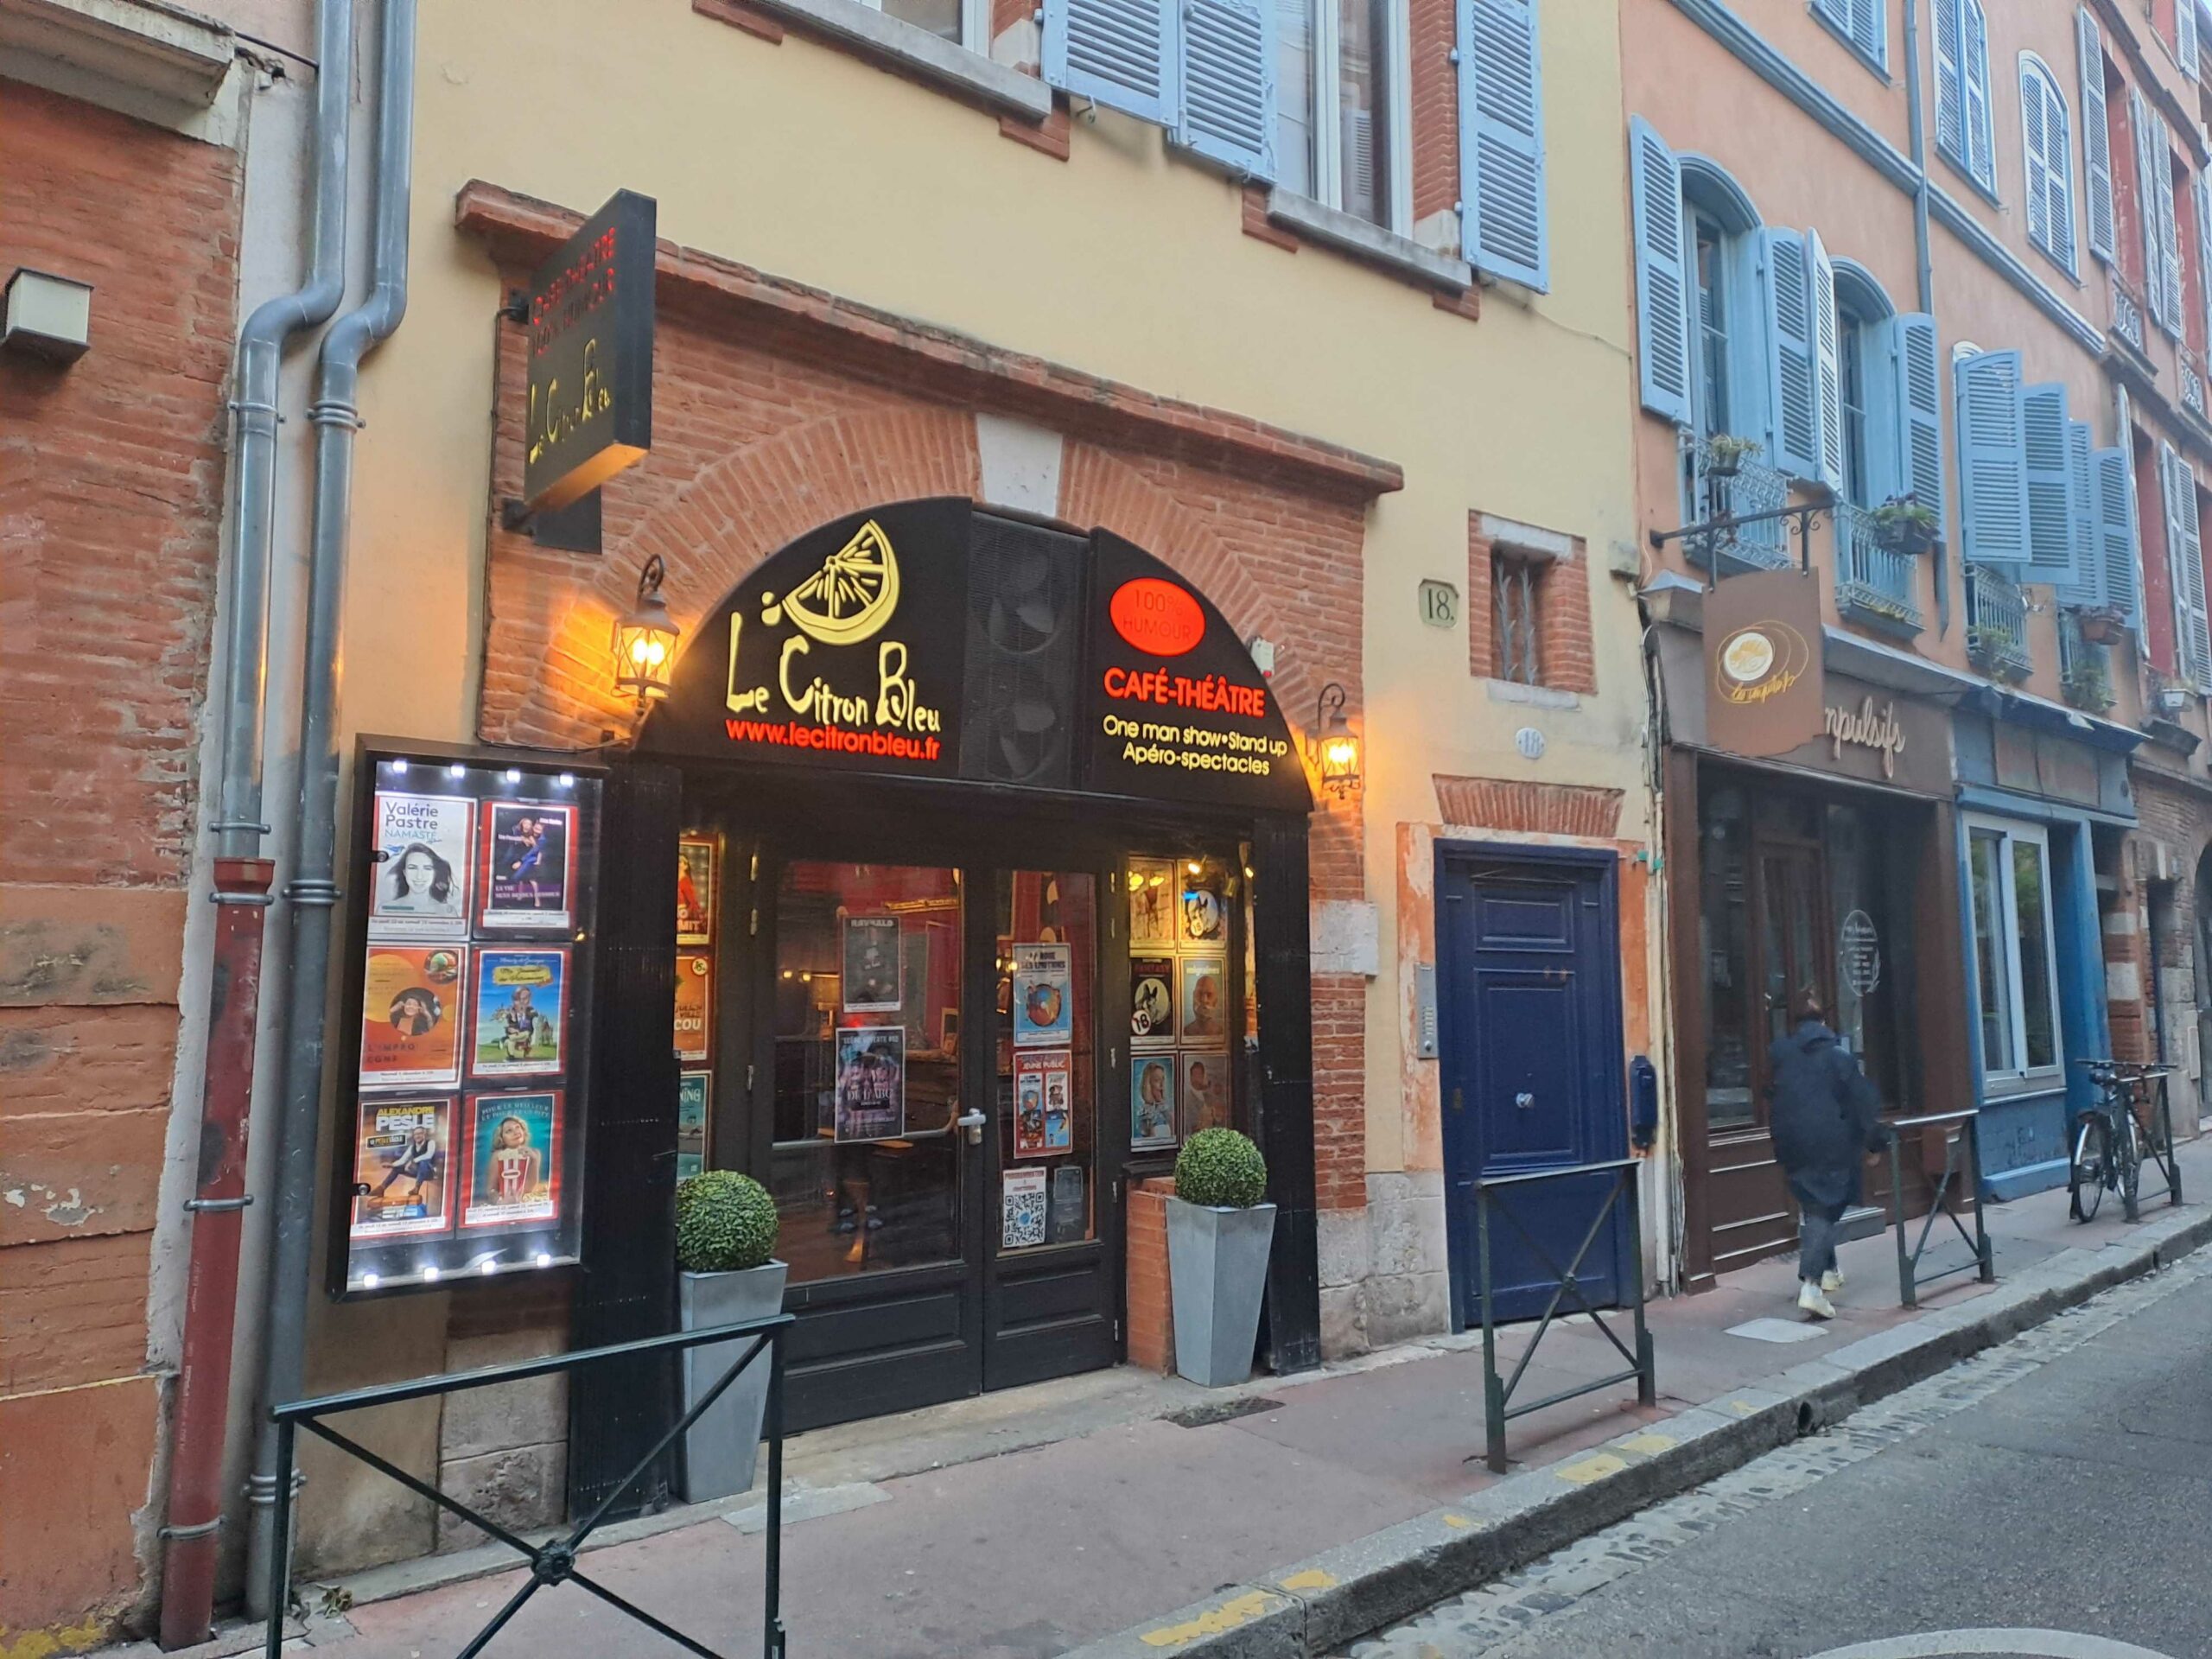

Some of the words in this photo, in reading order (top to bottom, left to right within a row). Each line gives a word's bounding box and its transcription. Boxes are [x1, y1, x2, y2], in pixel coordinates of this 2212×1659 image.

[1134, 588, 1184, 617] 100%
[1122, 616, 1192, 642] HUMOUR
[726, 611, 770, 713] Le
[779, 634, 869, 727] Citron
[875, 640, 941, 733] Bleu
[1103, 666, 1266, 719] CAFÉ-THÉÂTRE
[725, 718, 941, 760] www.lecitronbleu.fr
[1103, 715, 1140, 739] One
[1142, 722, 1180, 742] man
[1269, 740, 1288, 758] up
[1122, 741, 1270, 776] Apéro-spectacles
[385, 801, 439, 817] Valérie
[385, 814, 438, 830] Pastre
[1131, 1013, 1150, 1033] 18
[376, 1114, 435, 1131] PESLE
[378, 1106, 435, 1116] ALEXANDRE
